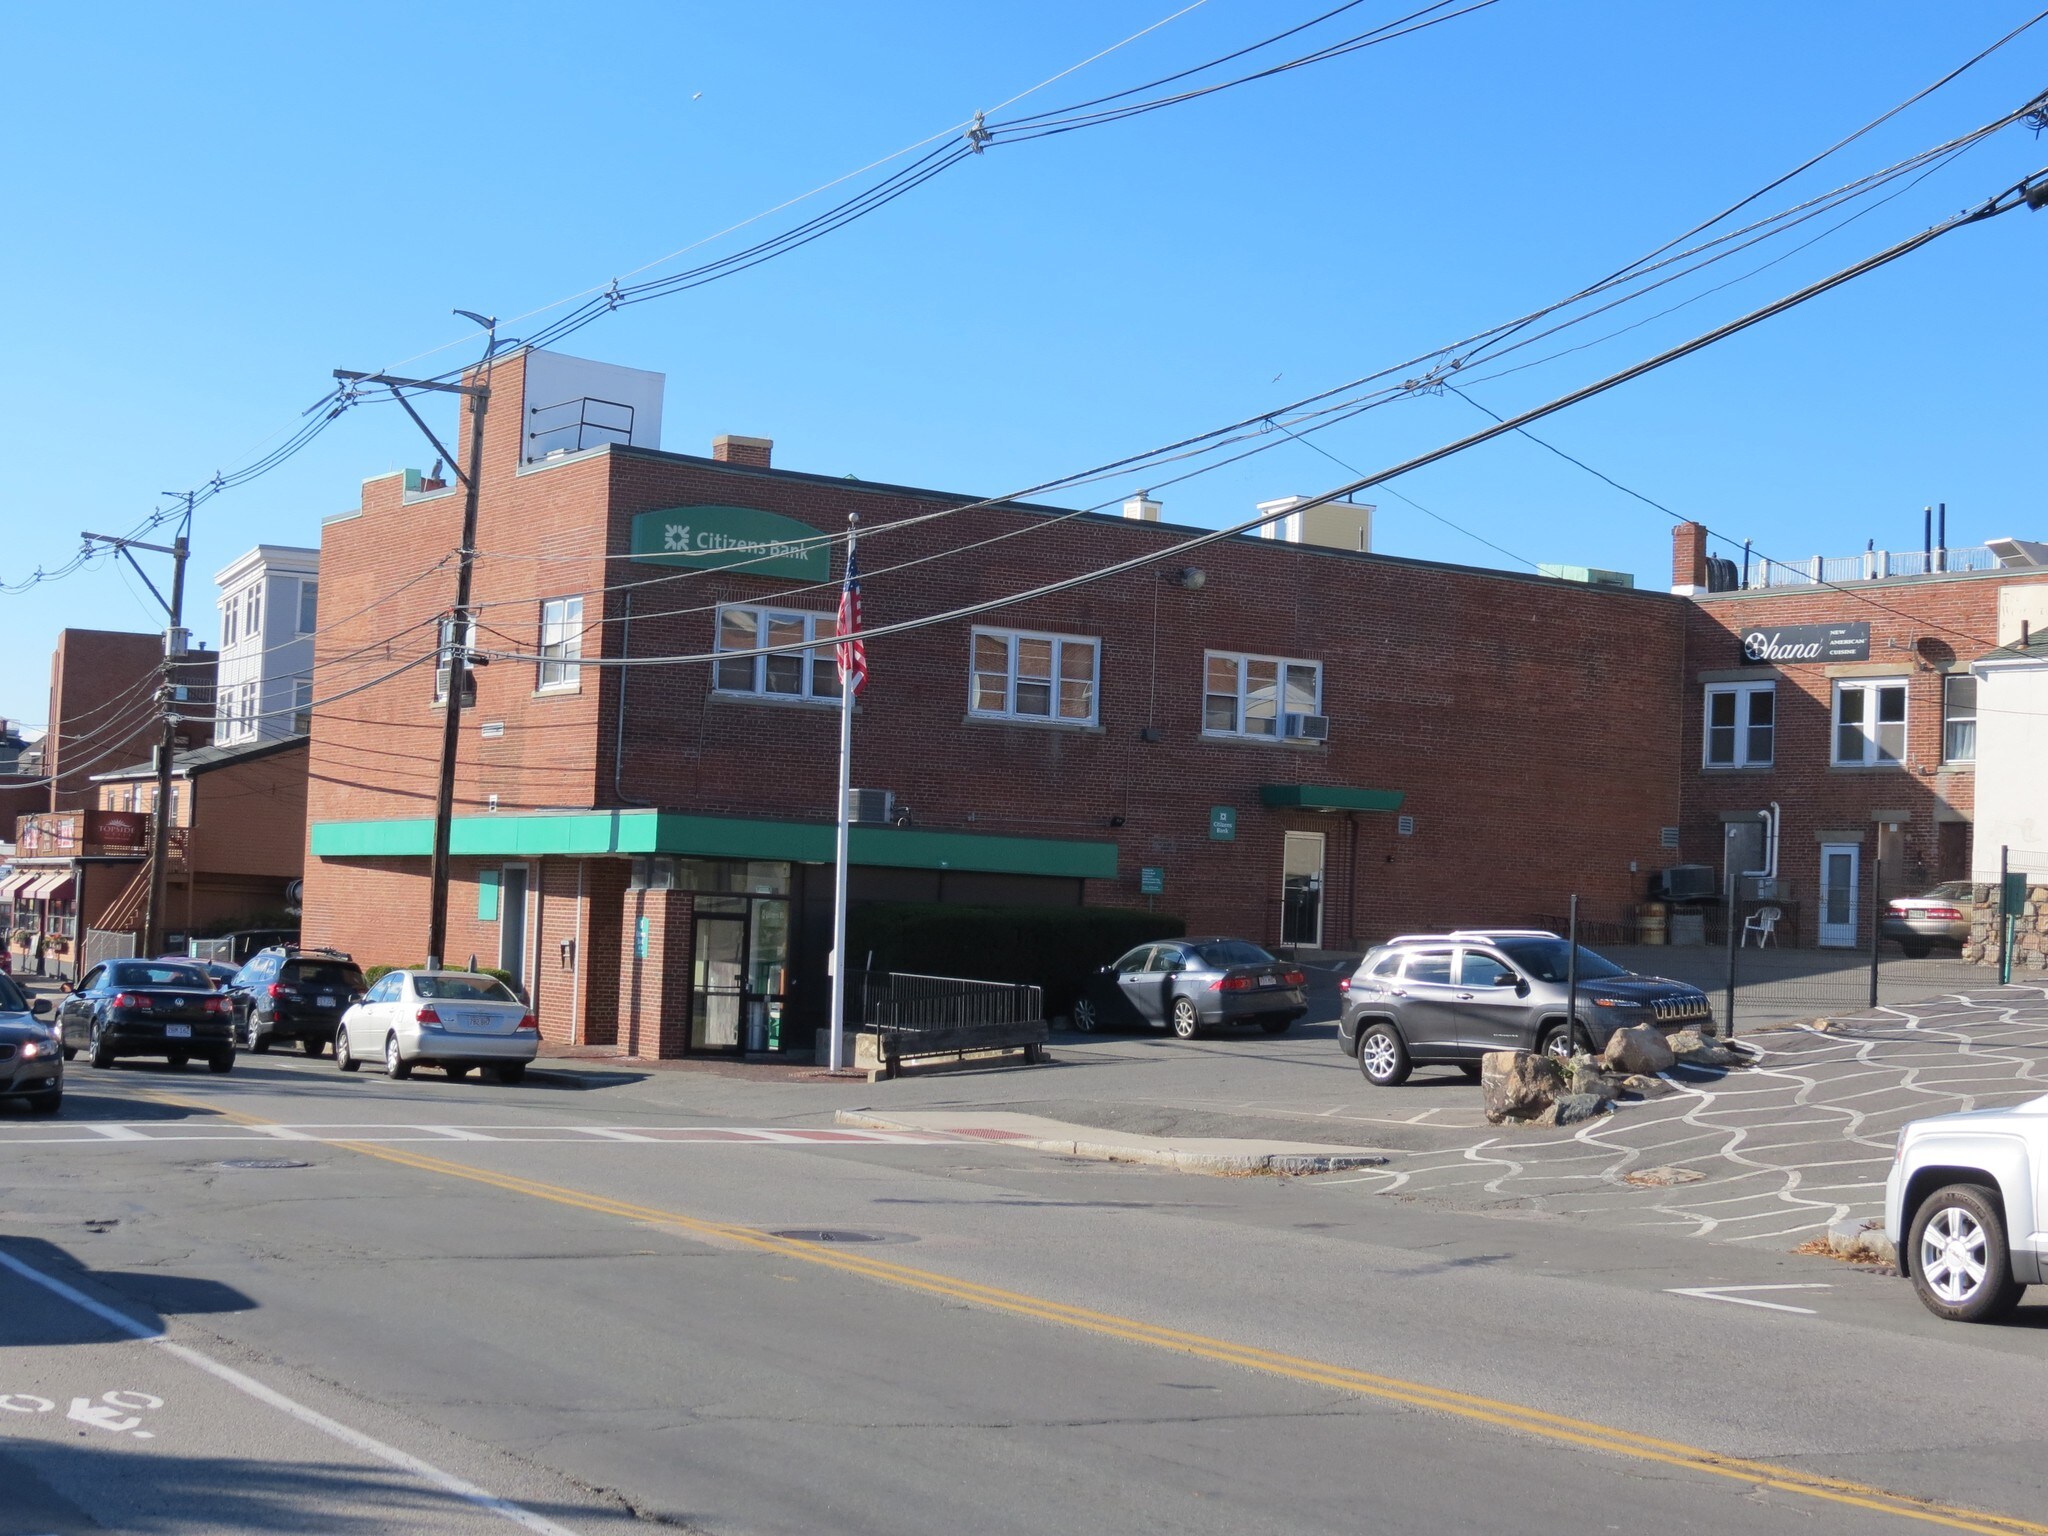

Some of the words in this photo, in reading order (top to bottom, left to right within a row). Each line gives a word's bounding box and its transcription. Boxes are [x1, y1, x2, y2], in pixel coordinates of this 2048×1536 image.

[696, 532, 766, 555] Citizens
[769, 540, 808, 560] Bank
[1744, 632, 1823, 660] Ohana
